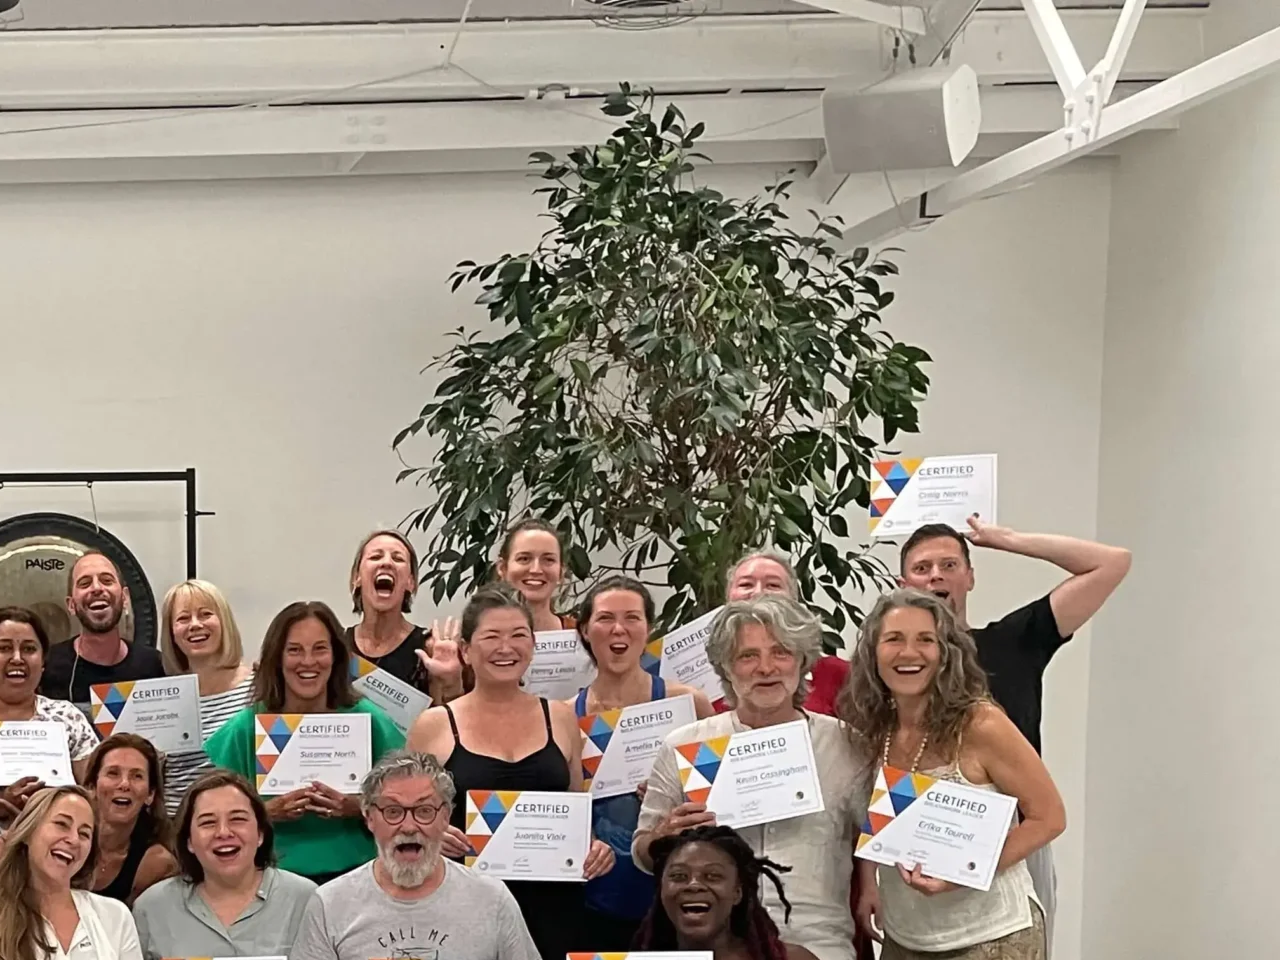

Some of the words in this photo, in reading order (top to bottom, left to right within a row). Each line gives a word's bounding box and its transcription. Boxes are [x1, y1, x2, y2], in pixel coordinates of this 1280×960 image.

[918, 465, 974, 476] CERTIFIED
[535, 640, 577, 650] ERTIFIED
[664, 626, 711, 655] CERTIFIED
[132, 686, 180, 699] CERTIFIED
[366, 675, 409, 704] CERTIFIED
[620, 710, 673, 728] CERTIFIED
[0, 729, 47, 737] CERTIFIED
[299, 724, 350, 734] CERTIFIED
[728, 737, 786, 757] CERTIFIED
[735, 775, 758, 785] Kevin
[515, 804, 570, 814] CERTIFIED
[926, 791, 988, 814] CERTIFIED
[918, 820, 941, 833] Erika
[378, 926, 416, 948] CALL
[428, 929, 450, 947] ME
